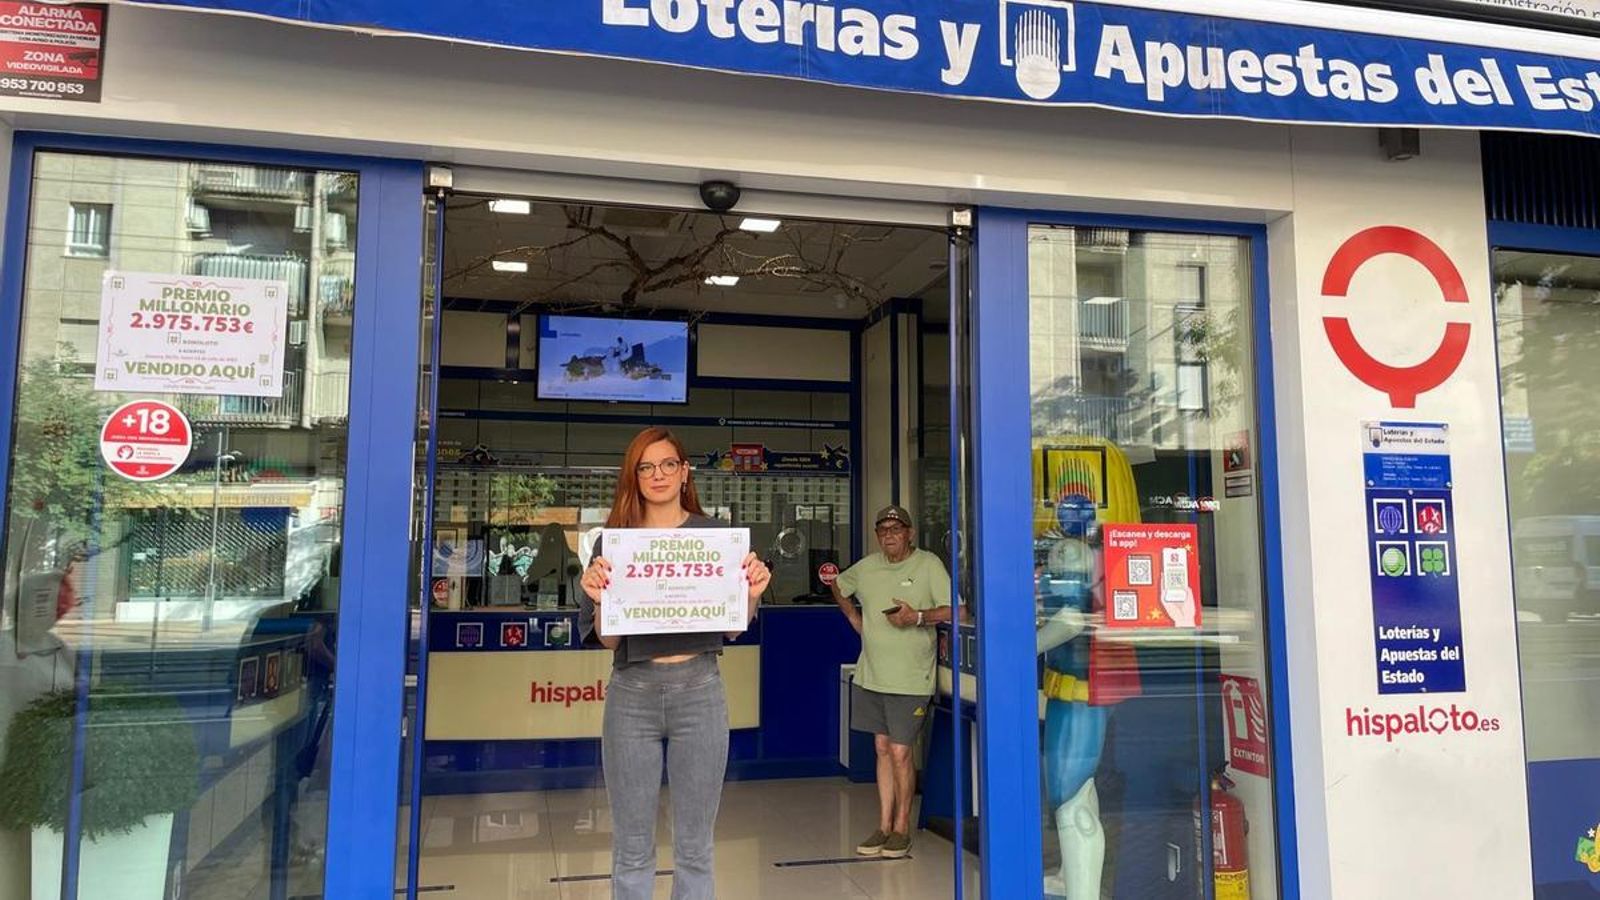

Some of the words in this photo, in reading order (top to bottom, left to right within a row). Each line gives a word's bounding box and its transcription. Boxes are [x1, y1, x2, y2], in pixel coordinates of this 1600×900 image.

[18, 6, 83, 20] ALARMA
[0, 14, 97, 33] CONECTADA
[23, 50, 65, 63] ZONA
[939, 20, 981, 85] y
[1094, 24, 1398, 101] Apuestas
[1415, 53, 1509, 106] del
[6, 62, 83, 74] VIDEOVIGILADA
[0, 78, 28, 90] 953
[29, 80, 56, 92] 700
[57, 82, 84, 94] 953
[161, 287, 231, 302] PREMIO
[139, 298, 250, 316] MILLONARIO
[130, 312, 254, 333] 2.975.753€
[125, 361, 209, 376] VENDIDO
[209, 362, 255, 379] AQUÍ
[122, 408, 170, 435] +18
[1154, 530, 1191, 540] descarga
[650, 539, 704, 550] PREMIO
[632, 551, 721, 563] MILLONARIO
[626, 563, 724, 578] 2.975.753€
[623, 607, 687, 618] VENDIDO
[690, 603, 726, 619] AQUÍ
[1379, 625, 1429, 640] Loterías
[1432, 628, 1440, 642] y
[1381, 647, 1437, 664] Apuestas
[1440, 646, 1460, 660] del
[1382, 669, 1425, 684] Estado
[531, 680, 608, 707] hispal
[1233, 747, 1266, 764] EXTINTOR
